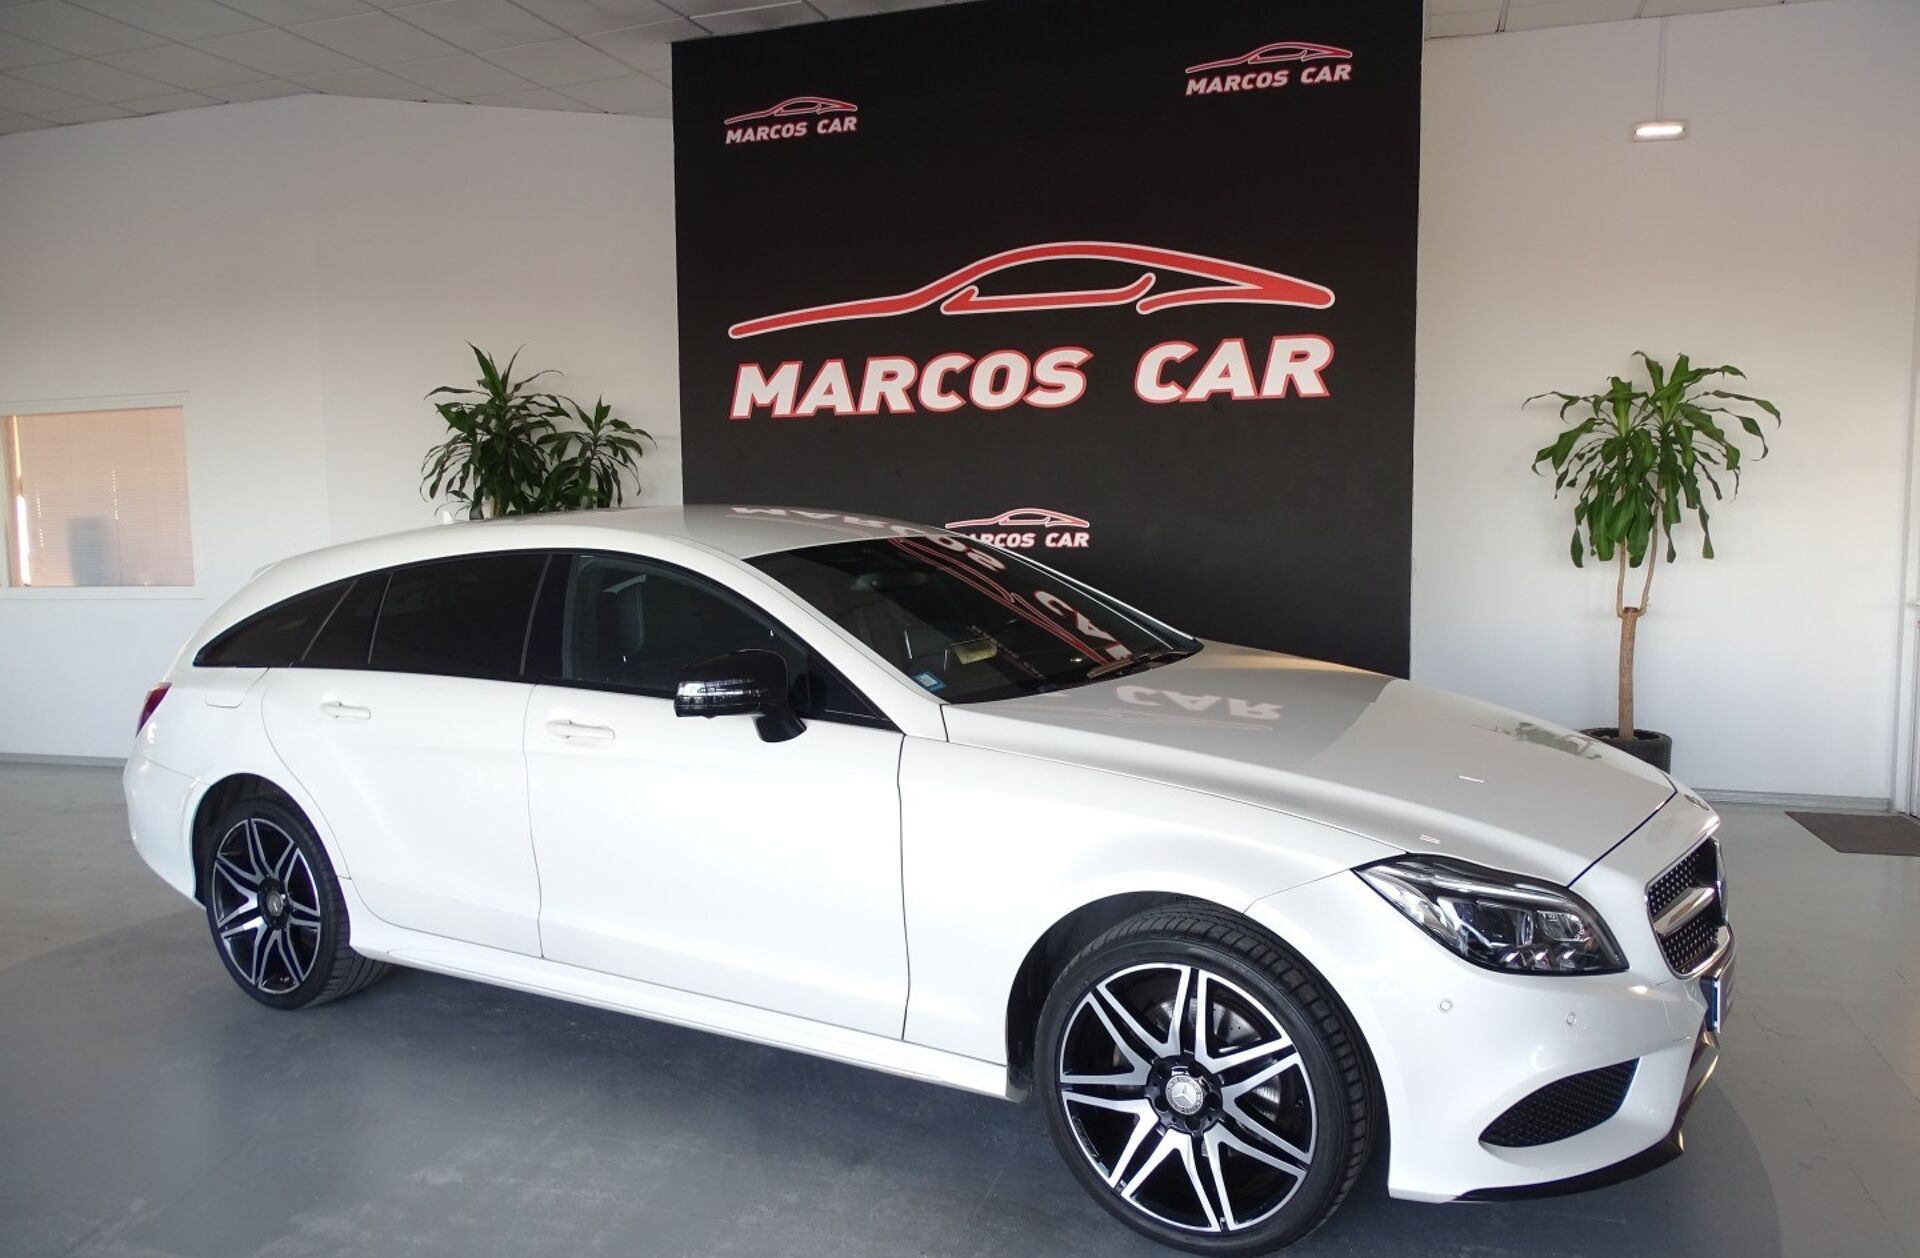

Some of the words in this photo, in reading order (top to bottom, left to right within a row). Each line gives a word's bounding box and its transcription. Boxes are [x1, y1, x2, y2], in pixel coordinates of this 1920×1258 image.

[1184, 69, 1291, 96] MARCOS
[1300, 63, 1352, 84] CAR
[724, 120, 809, 145] MARCOS
[815, 115, 858, 134] CAR
[728, 345, 1095, 421] MARCOS
[1133, 333, 1336, 405] CAR
[968, 532, 1038, 548] RCOS
[1044, 531, 1091, 548] CAR
